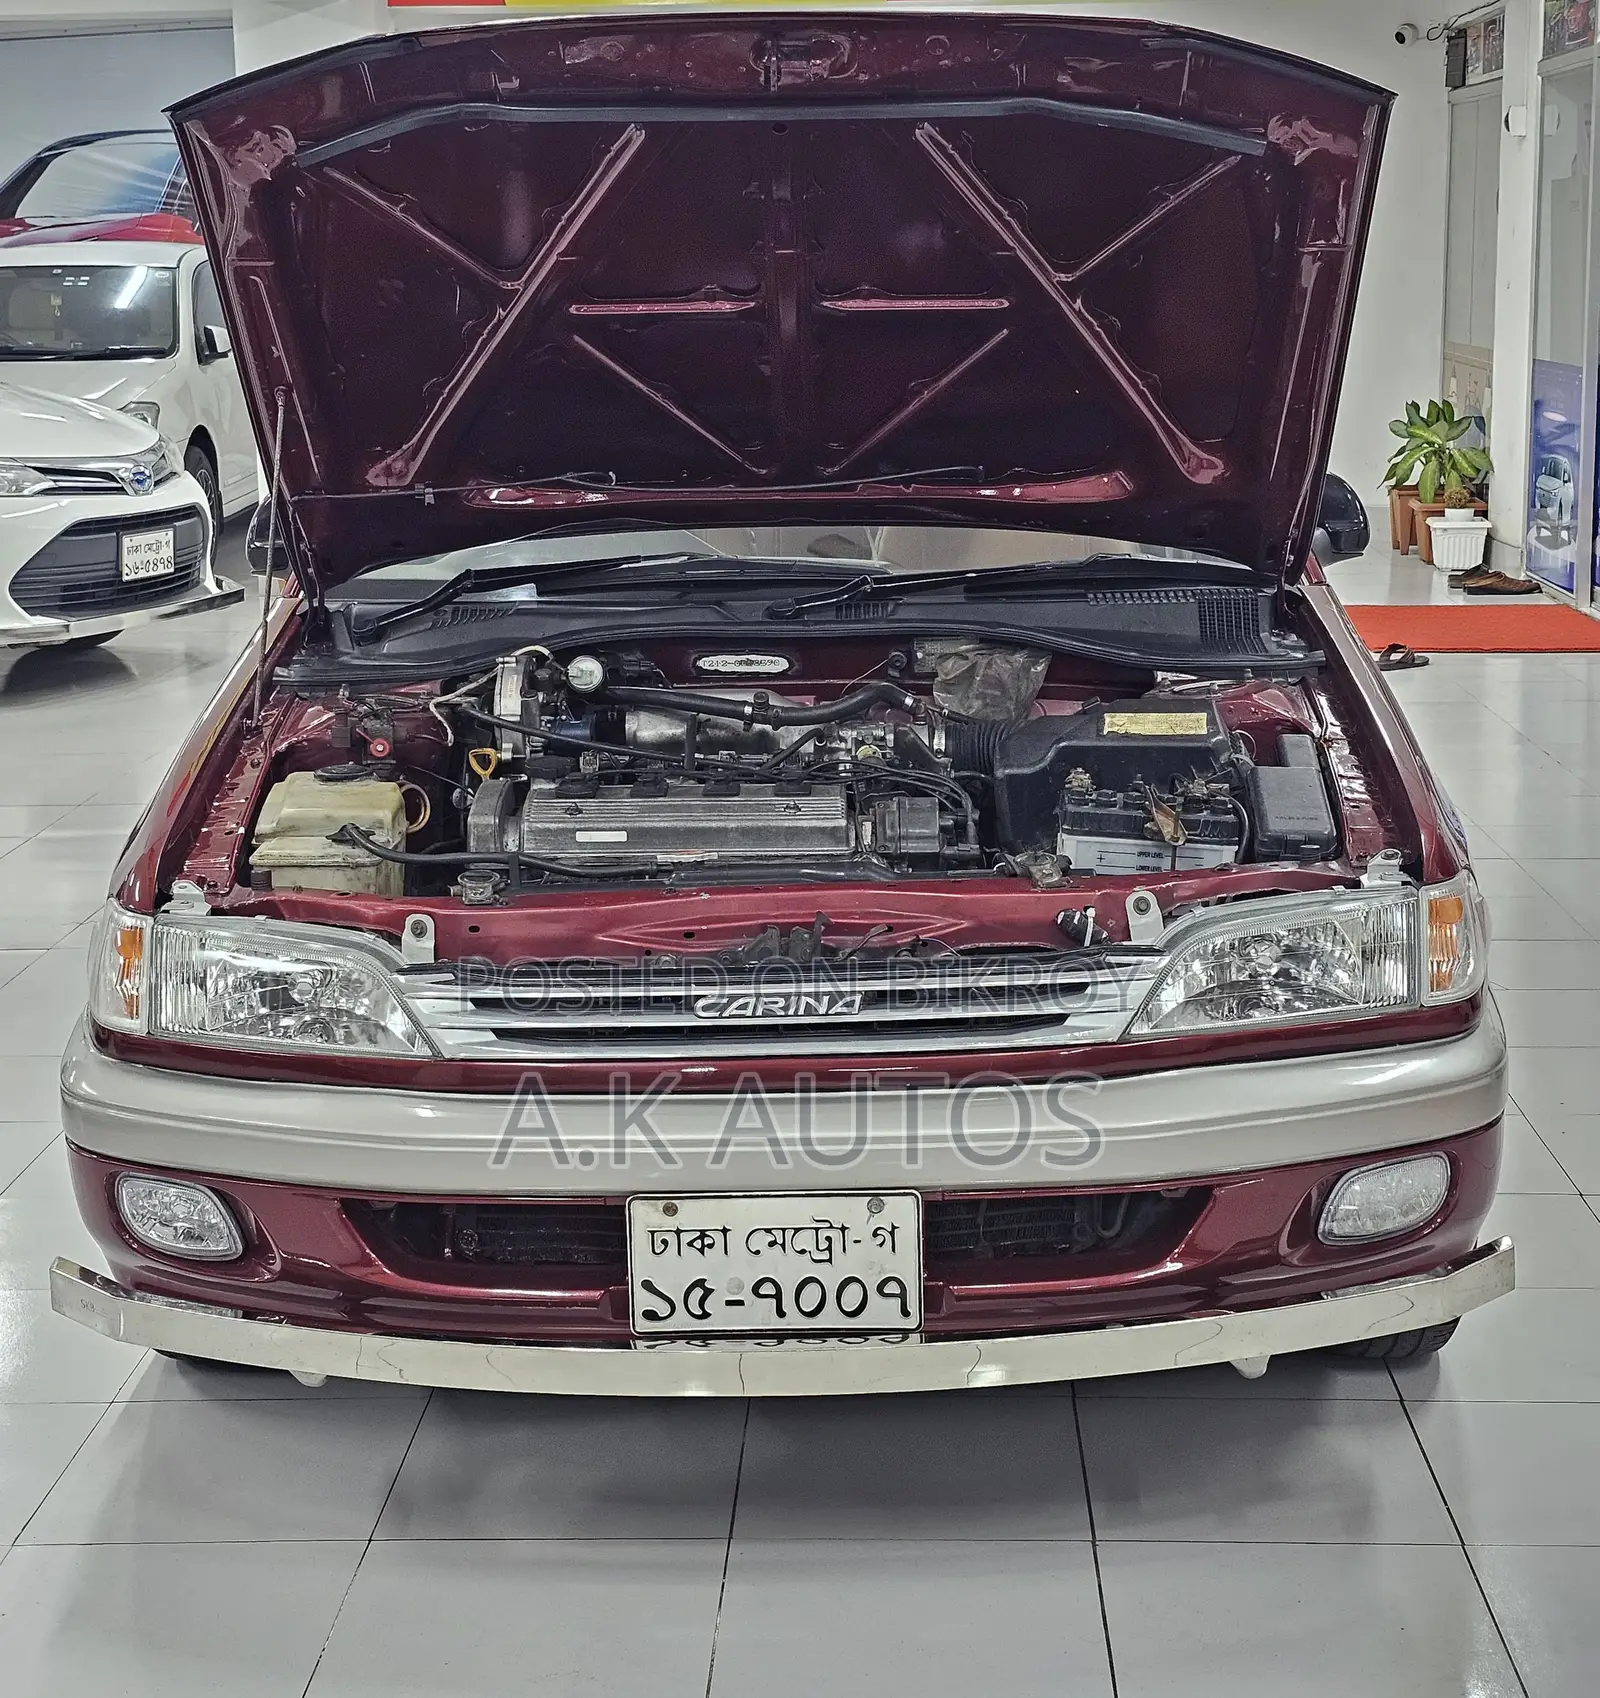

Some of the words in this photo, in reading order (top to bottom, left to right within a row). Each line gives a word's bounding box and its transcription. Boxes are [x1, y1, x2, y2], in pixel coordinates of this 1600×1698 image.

[694, 992, 863, 1018] CARINA
[647, 1225, 732, 1257] ঢাকা
[640, 1275, 912, 1321] ১৫-৭০০৭
